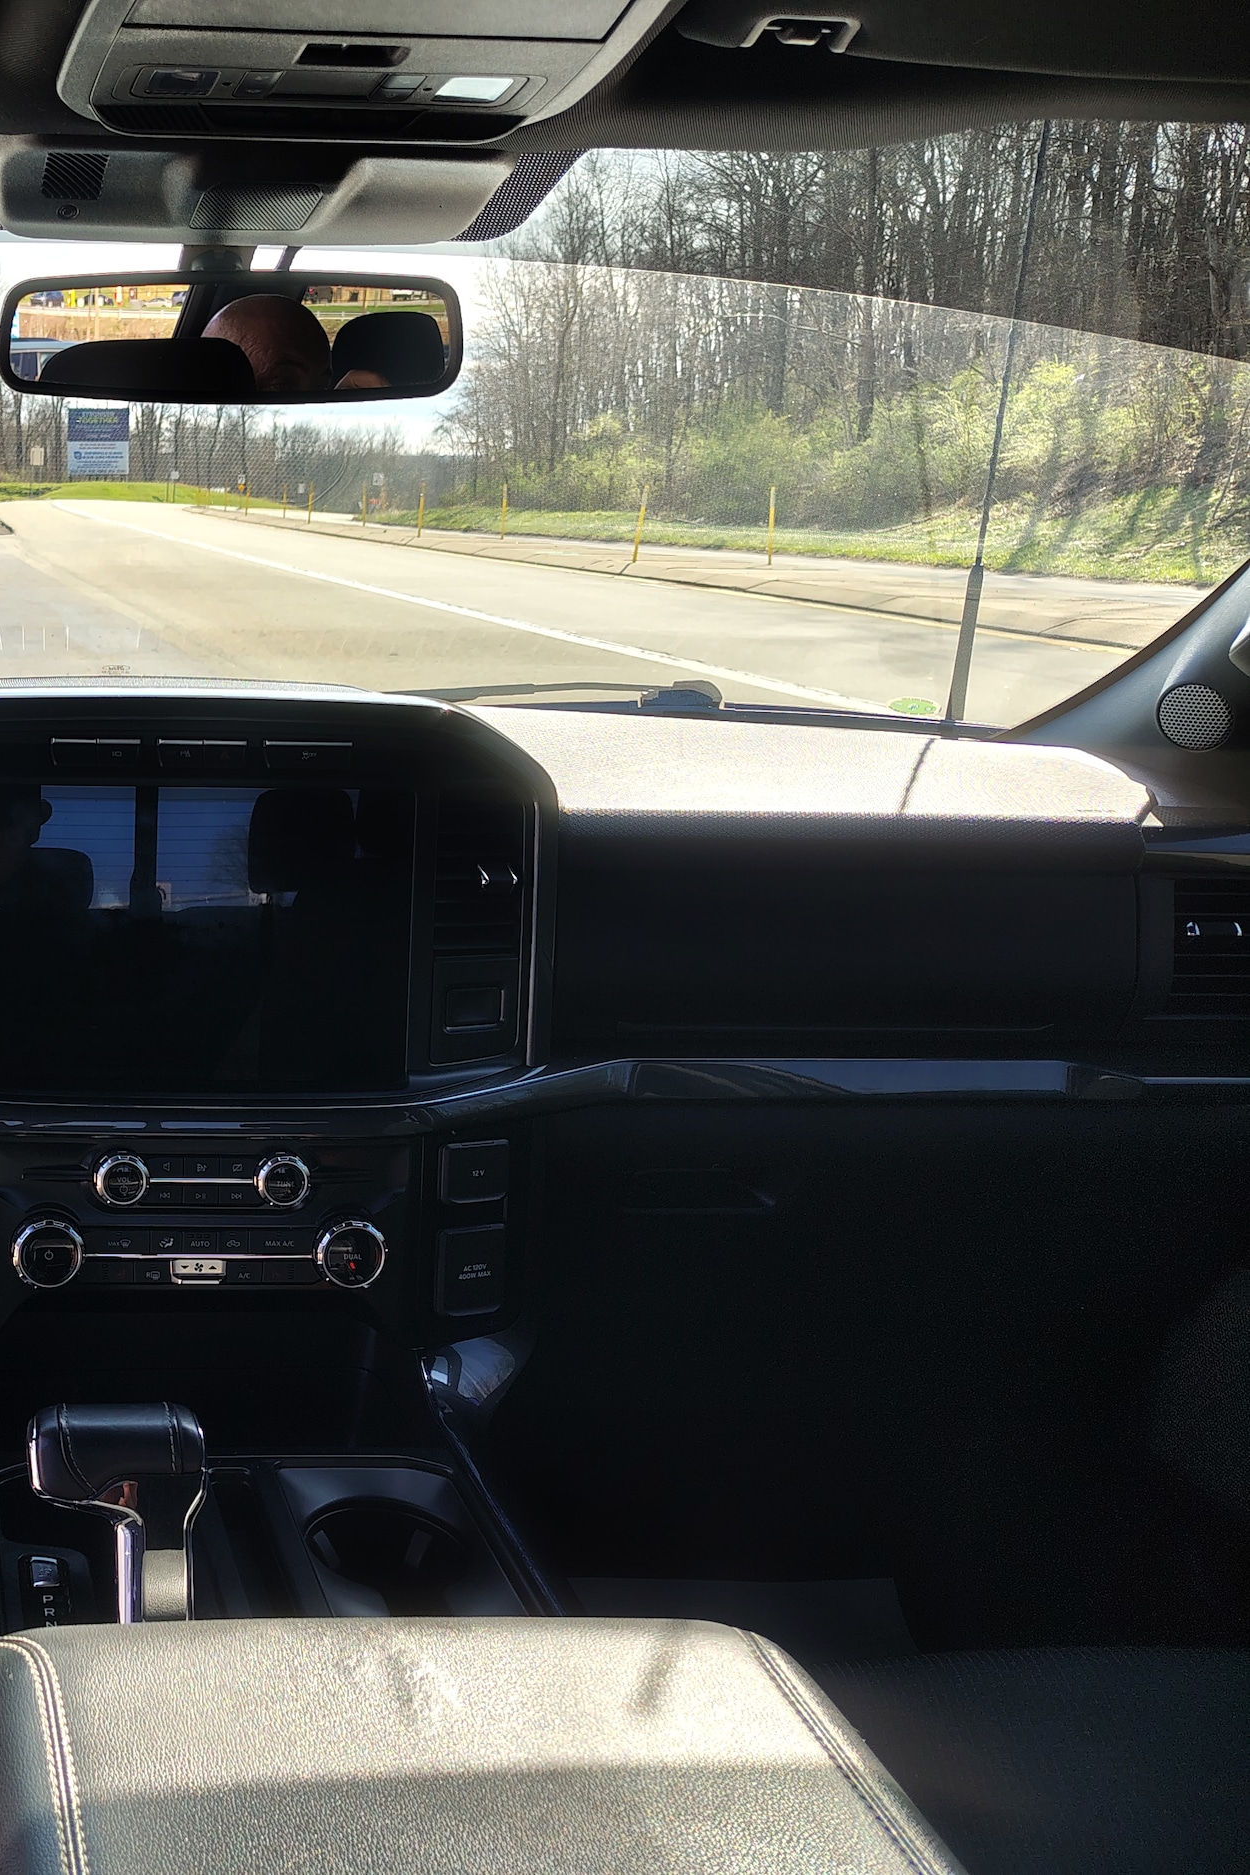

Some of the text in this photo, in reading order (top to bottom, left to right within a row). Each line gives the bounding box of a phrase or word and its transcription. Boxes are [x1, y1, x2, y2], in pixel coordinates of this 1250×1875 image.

[189, 1240, 211, 1248] AUTO
[281, 1240, 295, 1248] A/C
[463, 1264, 472, 1272] AC
[237, 1271, 251, 1279] A/C
[458, 1270, 492, 1281] 400W MAX
[42, 1594, 54, 1604] P
[43, 1607, 56, 1617] R
